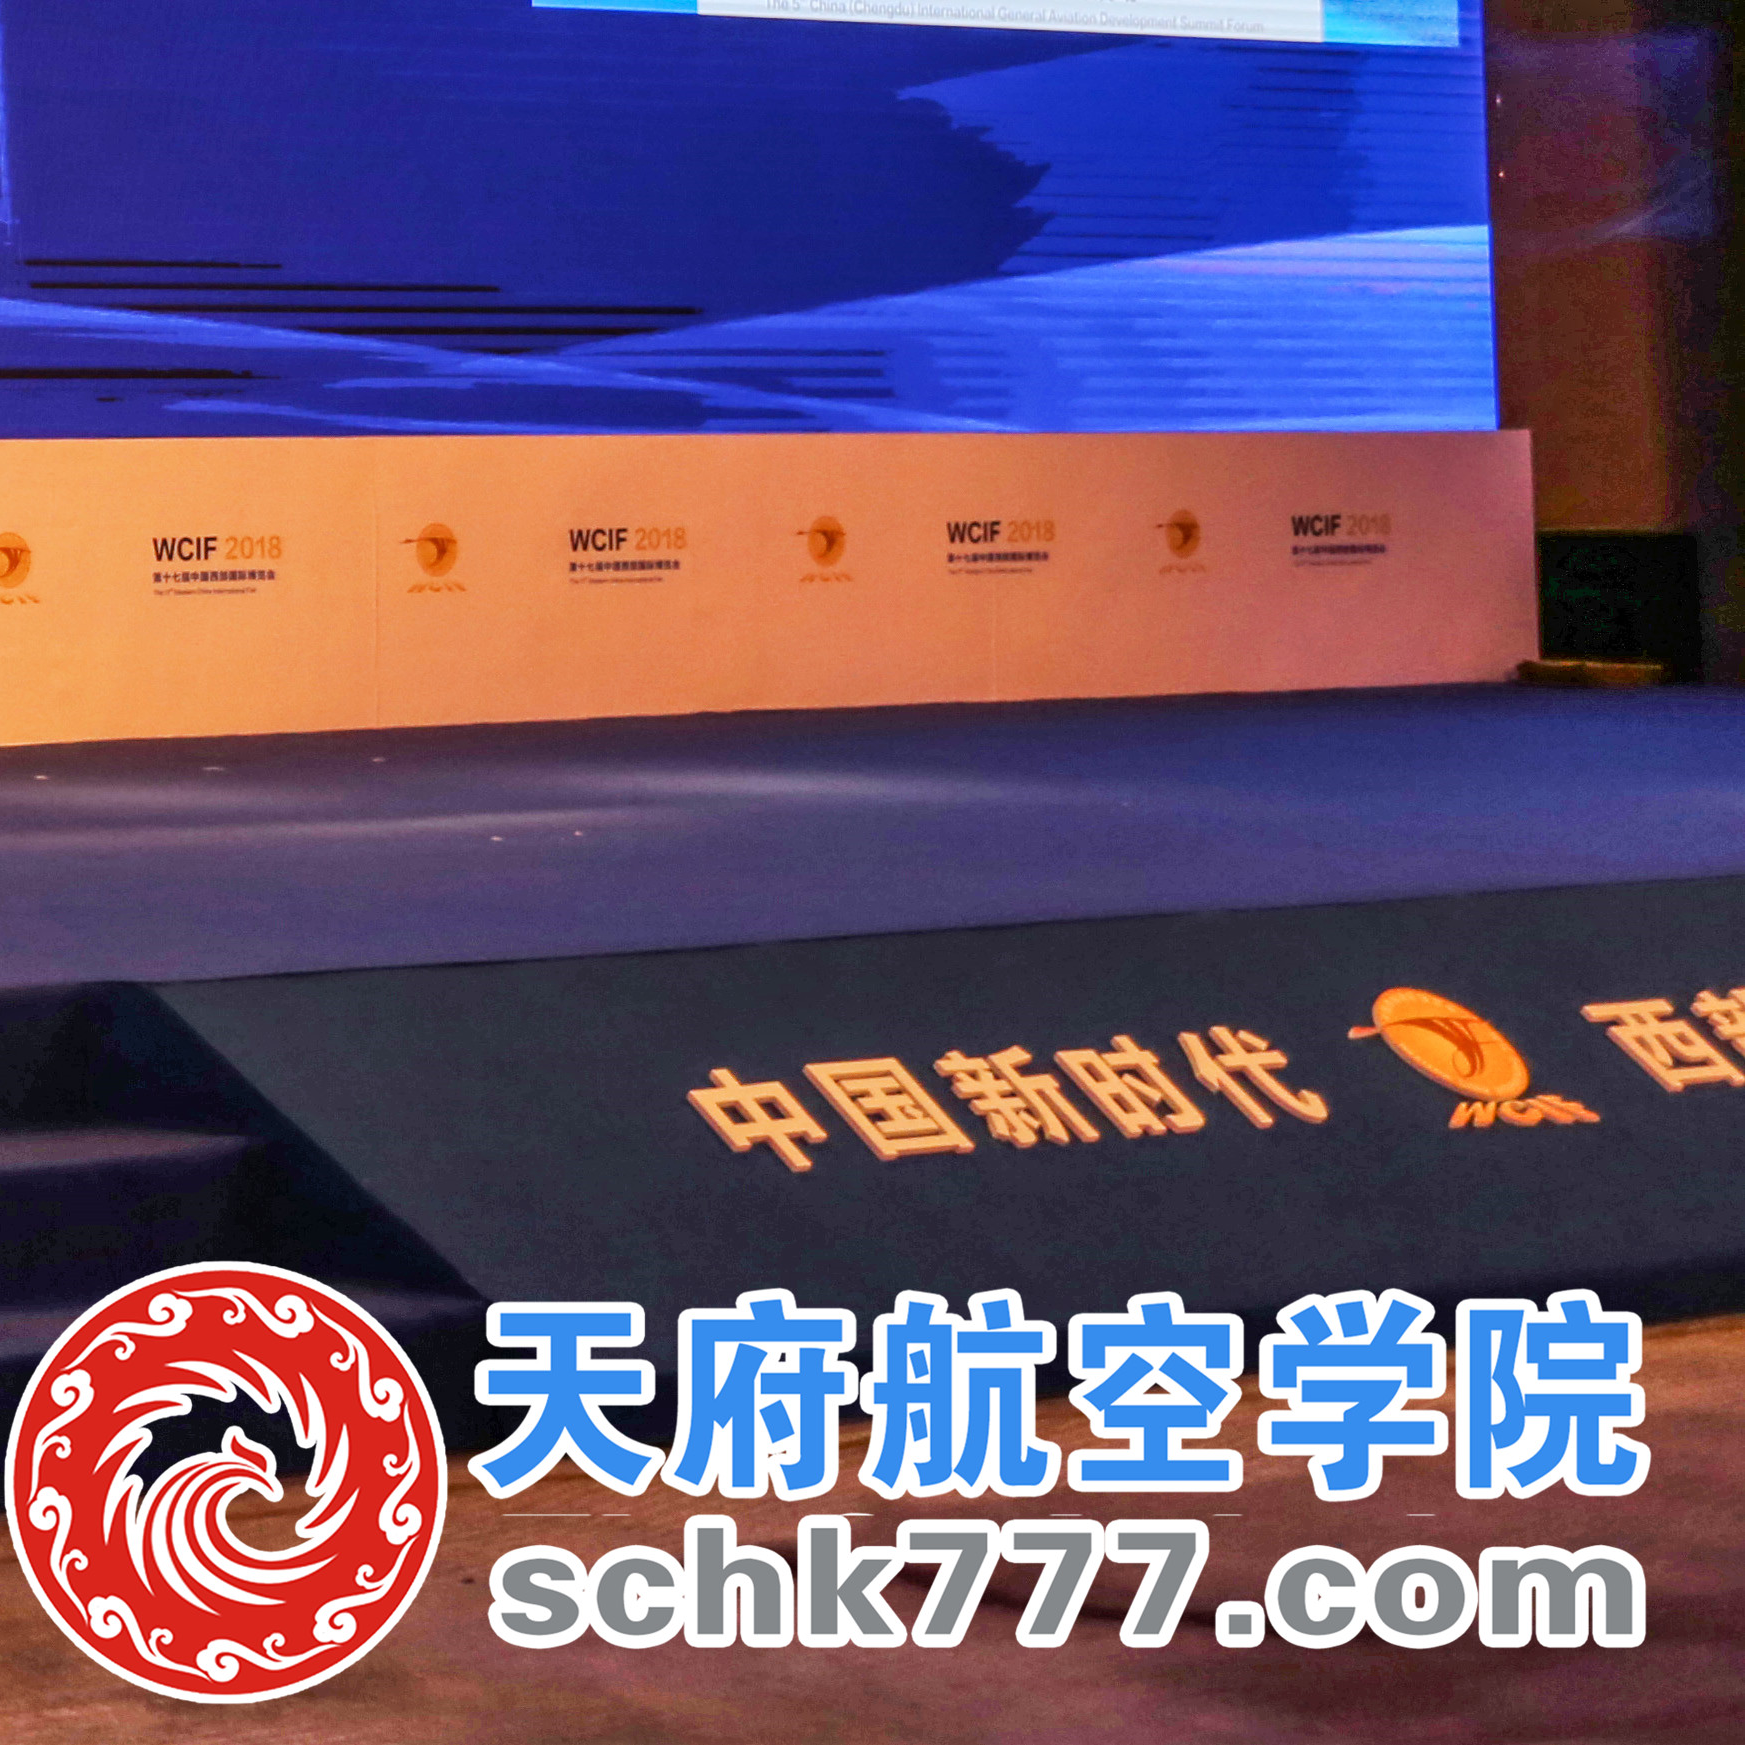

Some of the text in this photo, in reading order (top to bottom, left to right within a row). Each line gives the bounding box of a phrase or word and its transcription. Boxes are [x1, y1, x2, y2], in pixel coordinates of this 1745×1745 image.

[918, 3, 995, 20] International
[947, 520, 1055, 544] WCIF 2018
[1291, 514, 1342, 537] WCIF
[153, 536, 281, 561] WCIF 2018
[570, 527, 687, 552] WCIF 2018
[687, 1024, 1327, 1172] 中国新时代
